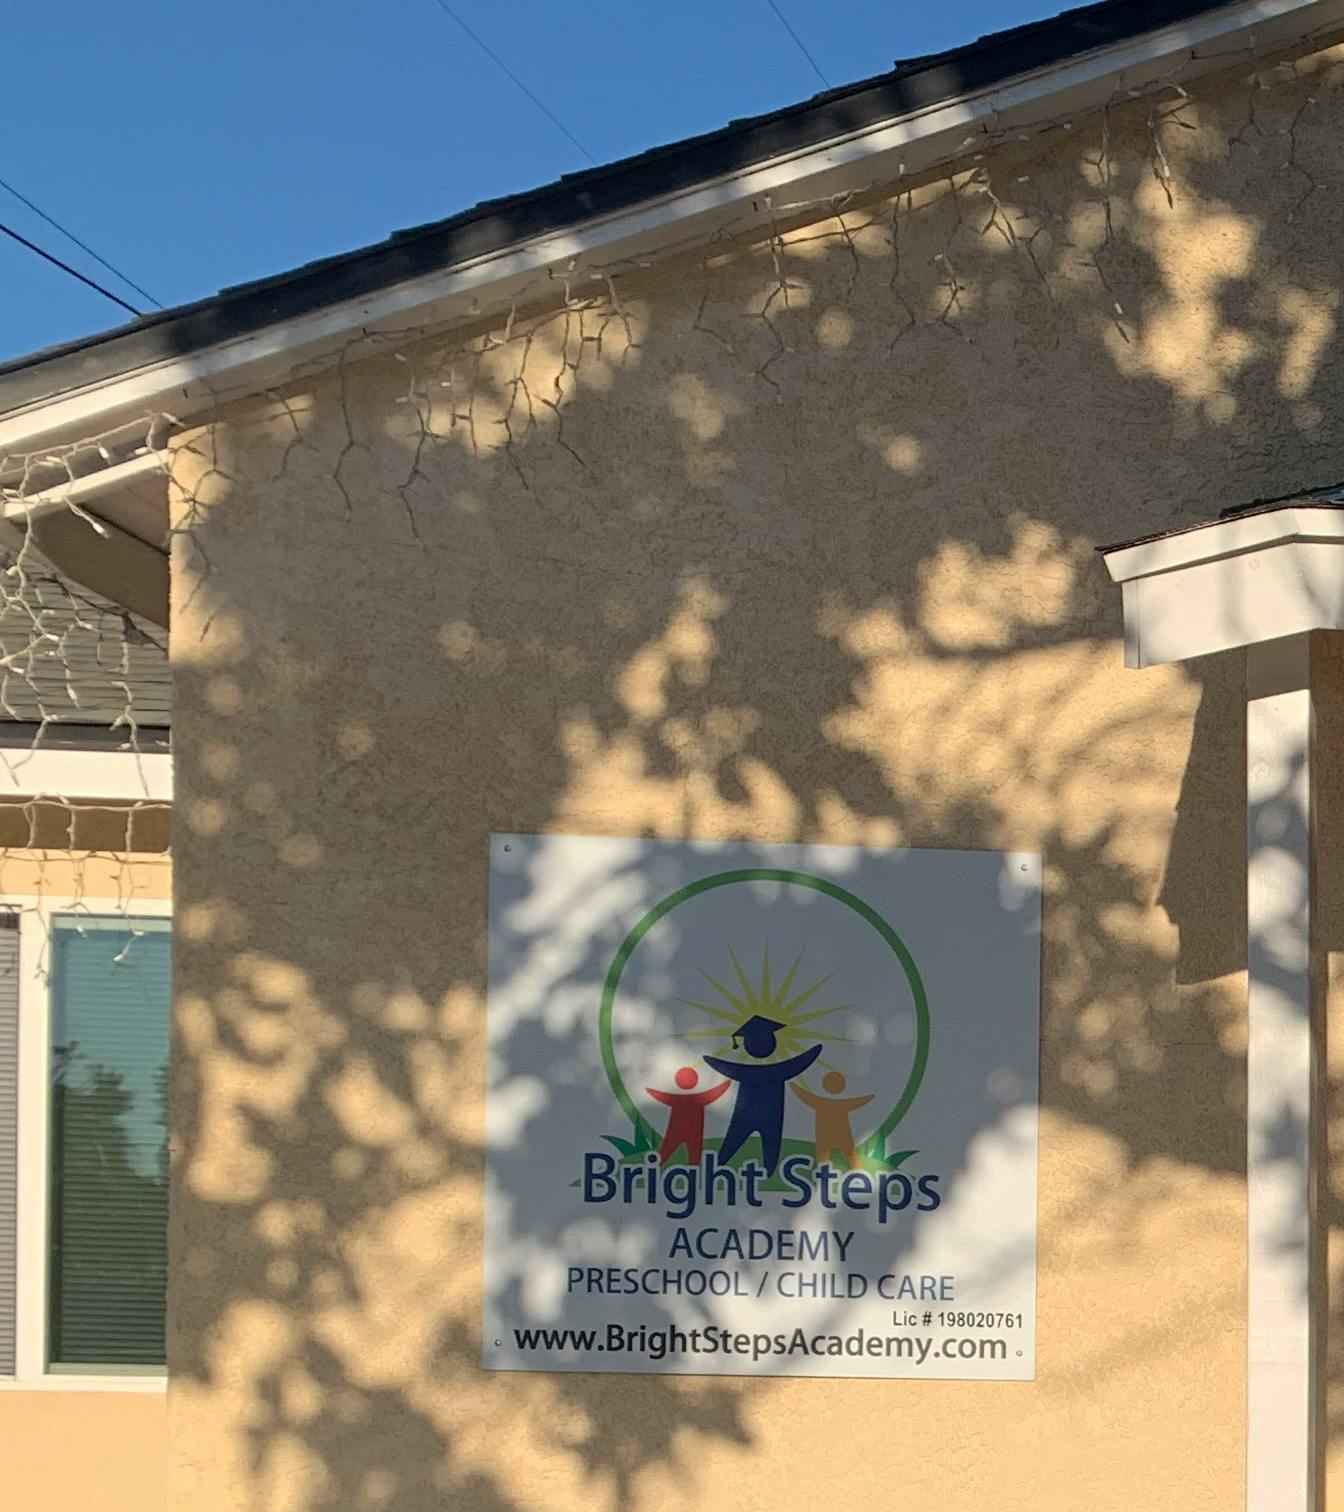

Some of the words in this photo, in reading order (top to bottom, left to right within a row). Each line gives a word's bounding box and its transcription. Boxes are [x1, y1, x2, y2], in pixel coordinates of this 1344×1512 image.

[582, 1152, 764, 1220] Bright
[781, 1153, 942, 1224] Steps
[668, 1227, 856, 1262] ACADEMY
[567, 1267, 749, 1296] PRESCHOOL
[776, 1271, 868, 1299] CHILD
[877, 1274, 955, 1301] CARE
[892, 1310, 918, 1327] Lic
[921, 1312, 933, 1326] #
[937, 1311, 1023, 1329] 198020761
[513, 1323, 1008, 1366] www.BrightStepsAcademy.com
